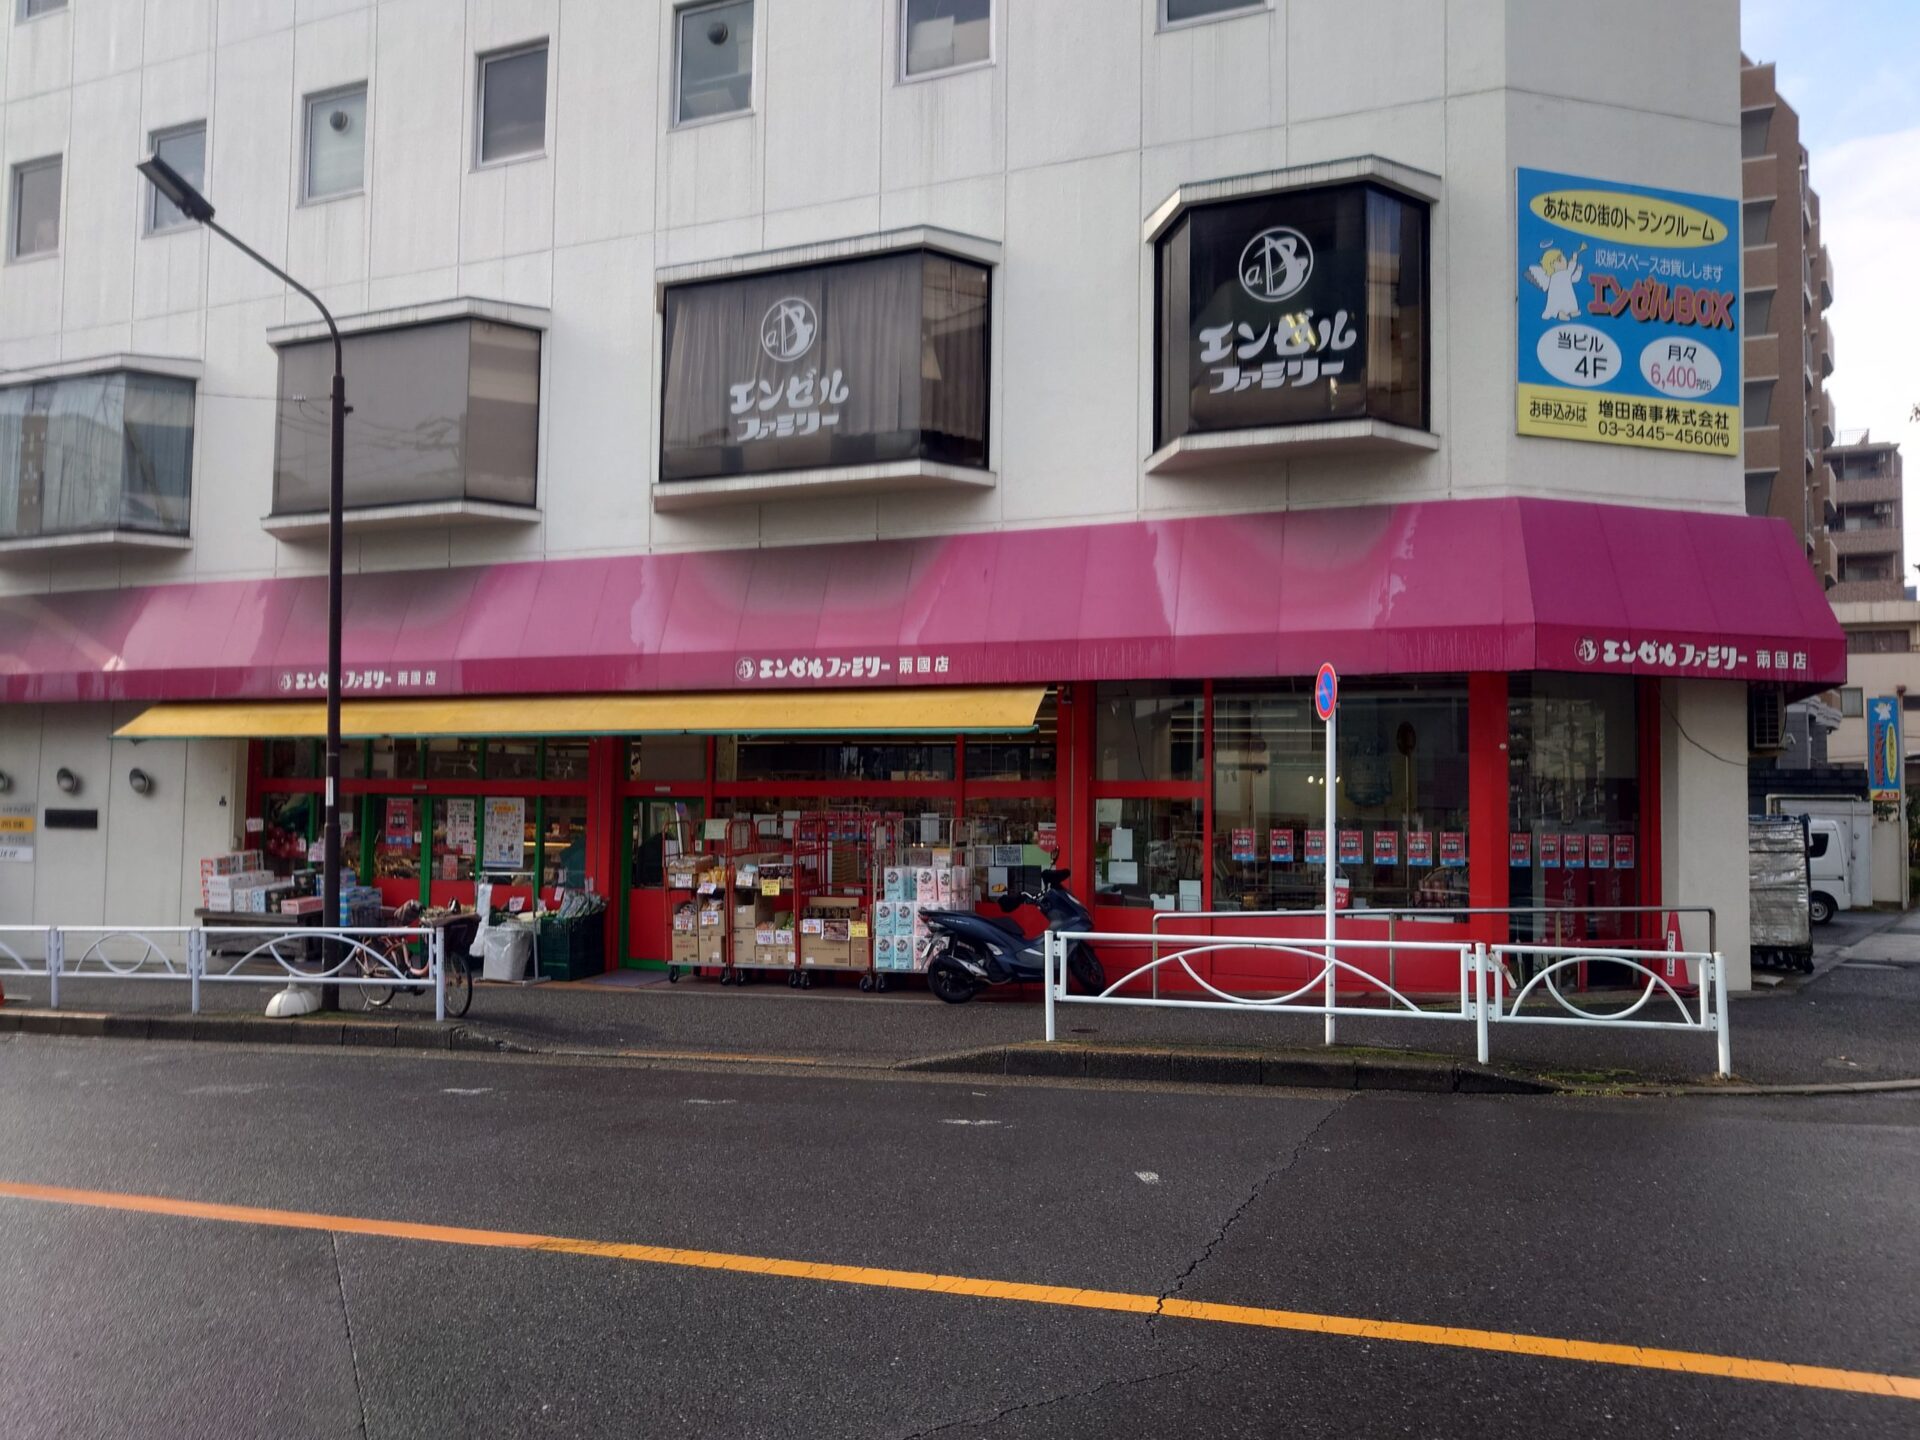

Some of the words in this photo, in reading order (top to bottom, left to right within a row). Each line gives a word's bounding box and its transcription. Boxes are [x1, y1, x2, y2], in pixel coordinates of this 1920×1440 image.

[1543, 197, 1714, 241] あなたの街のトランクルーム
[1595, 249, 1723, 283] 収納スペースお貸しします
[1588, 273, 1735, 329] エンゼルBOX
[1557, 332, 1603, 353] 当ビル
[1667, 345, 1698, 362] 月々
[1210, 358, 1344, 394] ファミリー
[1575, 356, 1608, 379] 4F
[737, 411, 839, 442] ファミリー
[1529, 401, 1587, 423] お申込みは
[1598, 400, 1729, 430] 増田商事株式会社
